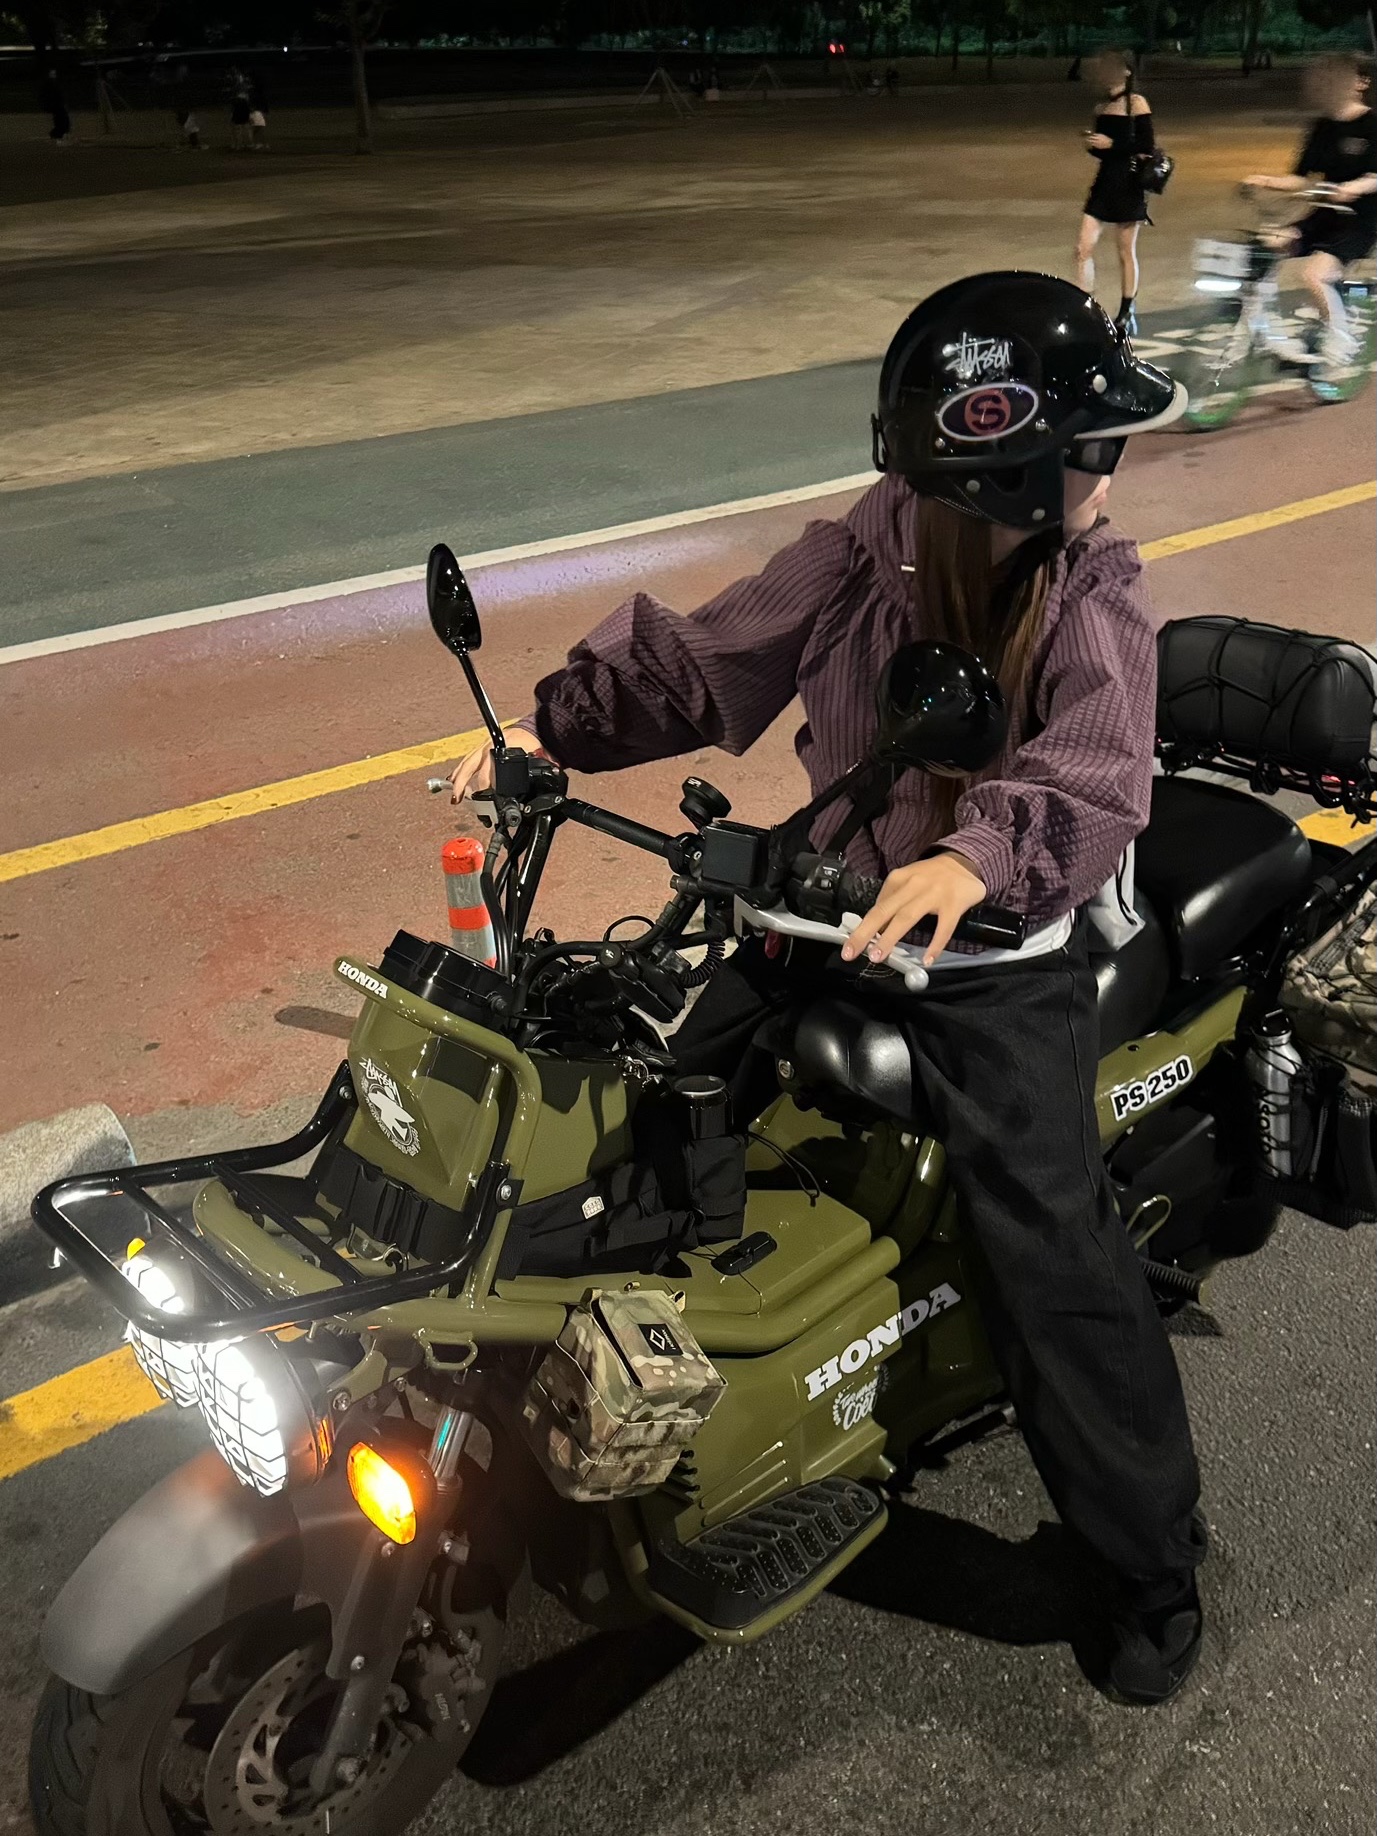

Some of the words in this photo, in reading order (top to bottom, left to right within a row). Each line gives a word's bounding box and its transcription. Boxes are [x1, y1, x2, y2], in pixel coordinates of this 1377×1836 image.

[337, 961, 389, 999] HONDA
[1112, 1057, 1191, 1119] PS250
[804, 1282, 962, 1401] HONDA
